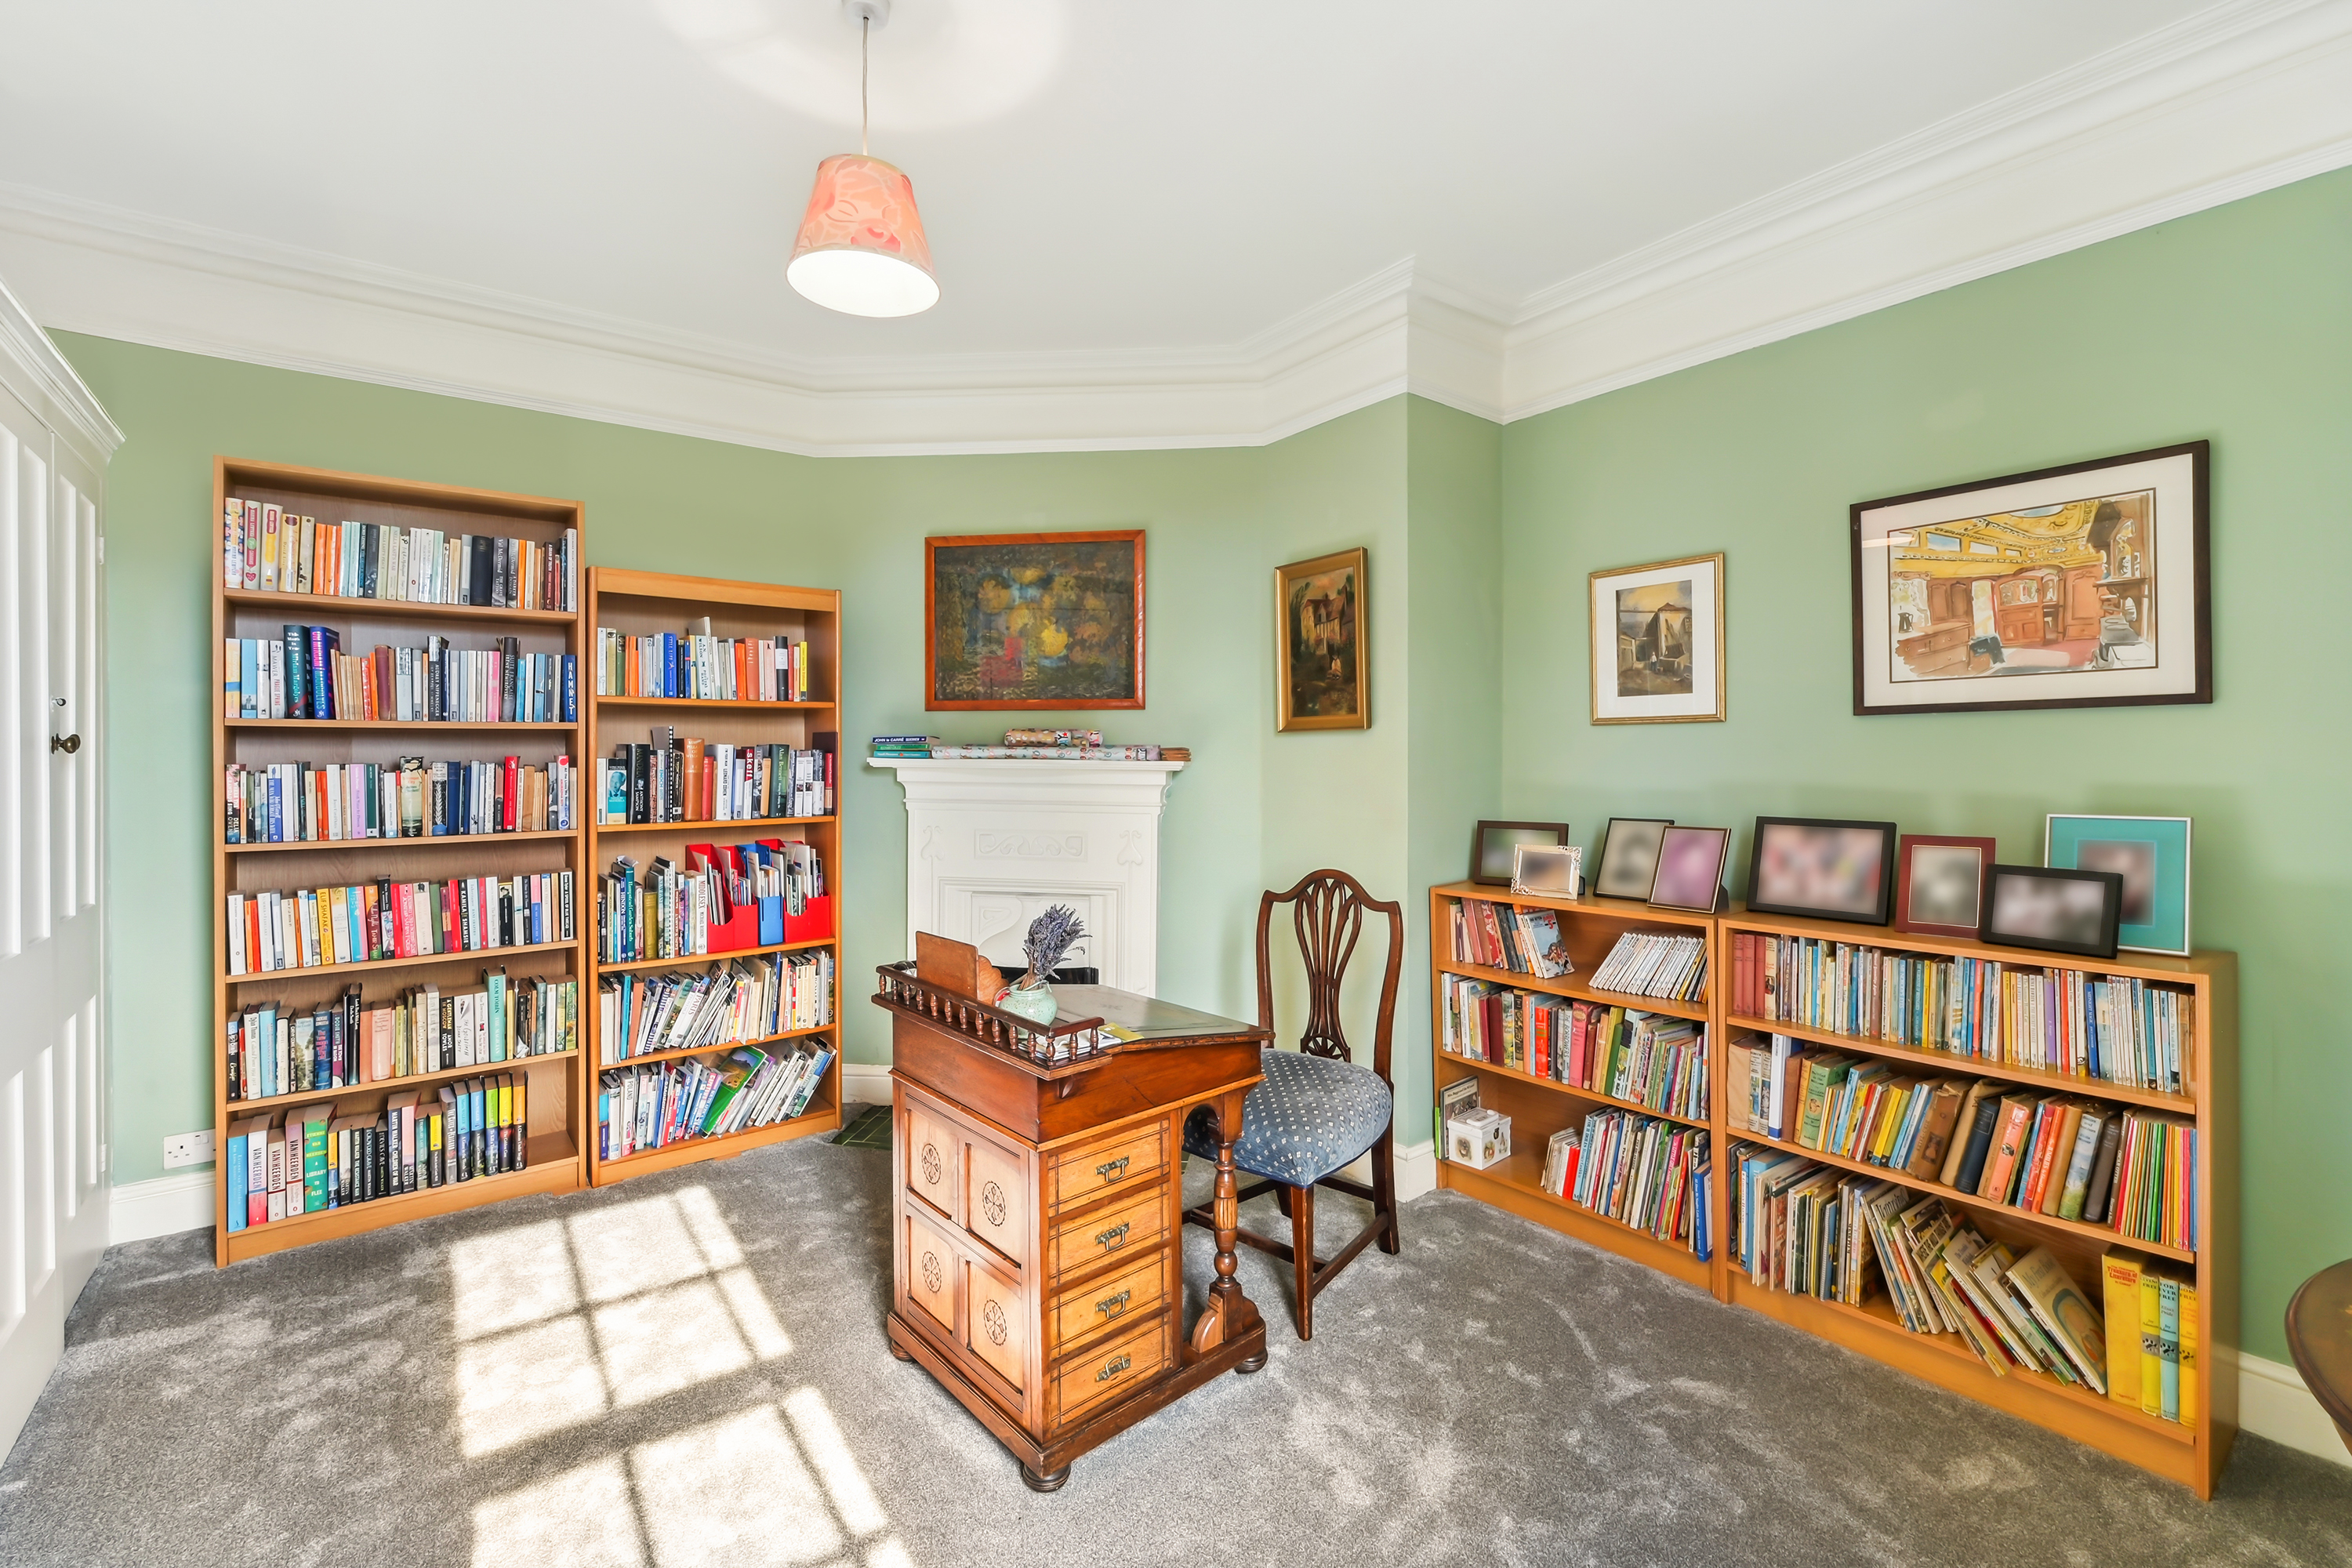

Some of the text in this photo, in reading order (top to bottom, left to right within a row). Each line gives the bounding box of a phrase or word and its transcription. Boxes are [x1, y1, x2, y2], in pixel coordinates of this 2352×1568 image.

[1548, 920, 1554, 929] 5
[688, 995, 702, 1016] PARIS
[253, 1148, 262, 1189] VAN HEERDEN
[272, 1149, 281, 1190] VAN HEERDEN
[290, 1153, 299, 1180] HEERDEN
